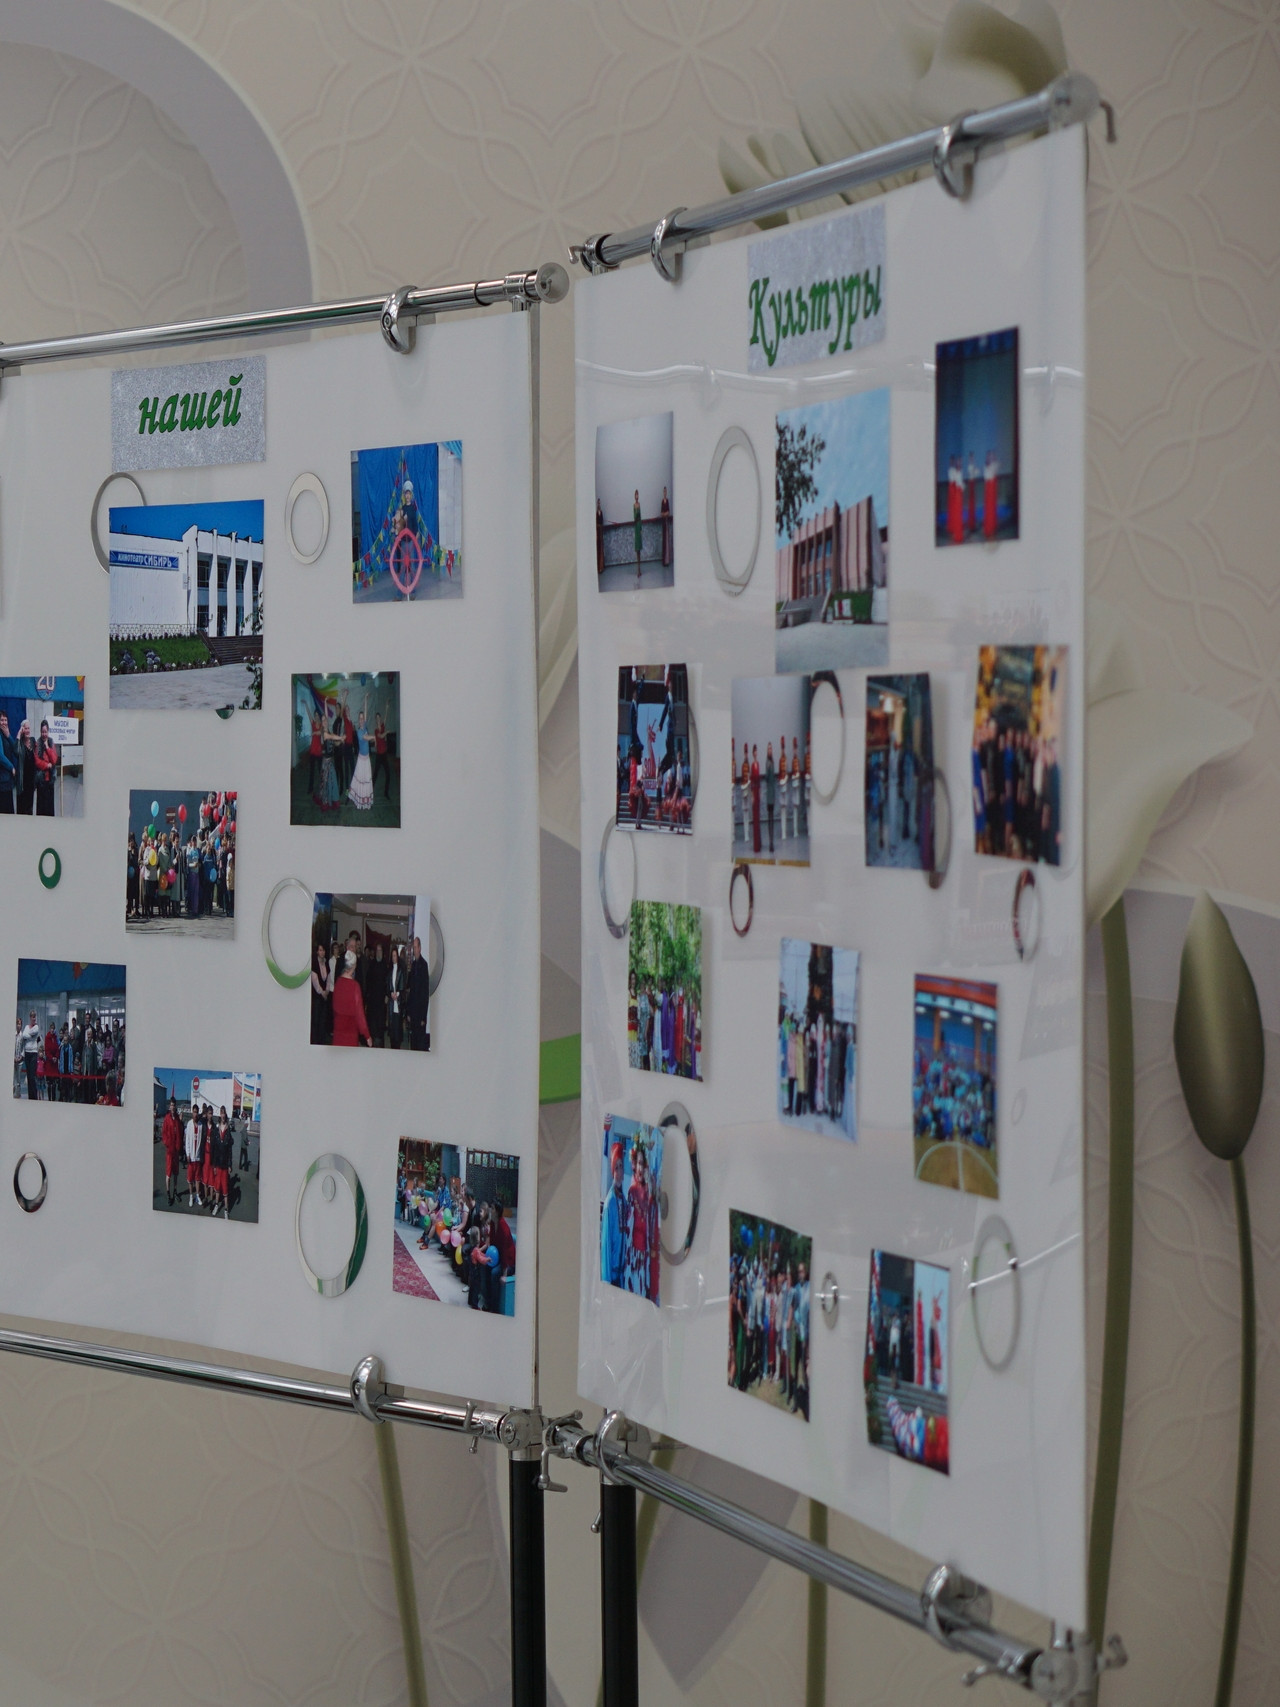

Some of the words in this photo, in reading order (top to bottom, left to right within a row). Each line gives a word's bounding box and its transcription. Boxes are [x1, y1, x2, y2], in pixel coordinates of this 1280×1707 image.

[748, 263, 882, 367] Культуры
[138, 372, 243, 435] нашей
[144, 555, 172, 567] СИБИРЬ
